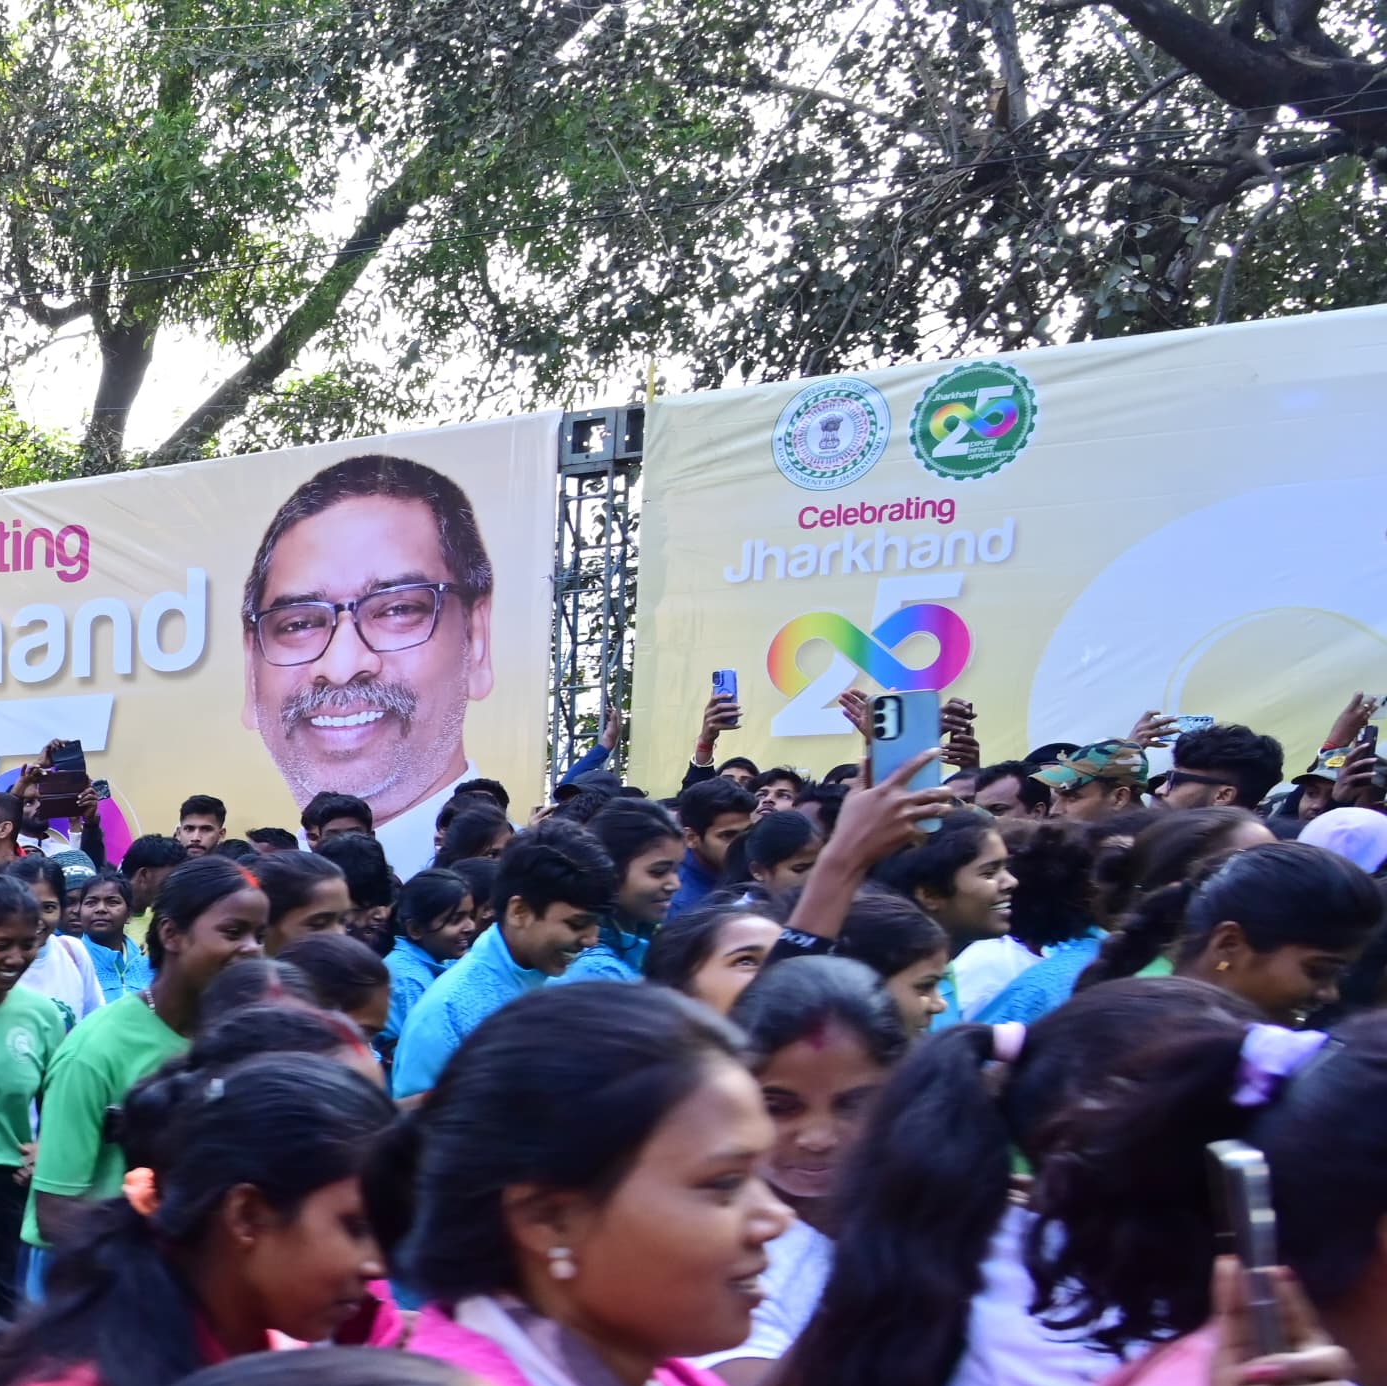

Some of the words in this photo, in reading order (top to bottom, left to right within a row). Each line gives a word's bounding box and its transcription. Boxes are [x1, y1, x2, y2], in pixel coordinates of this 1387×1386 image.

[933, 388, 979, 401] Jharkhand
[778, 447, 823, 486] GOVERNMENT
[798, 496, 956, 530] Celebrating
[723, 516, 1017, 584] Jharkhand
